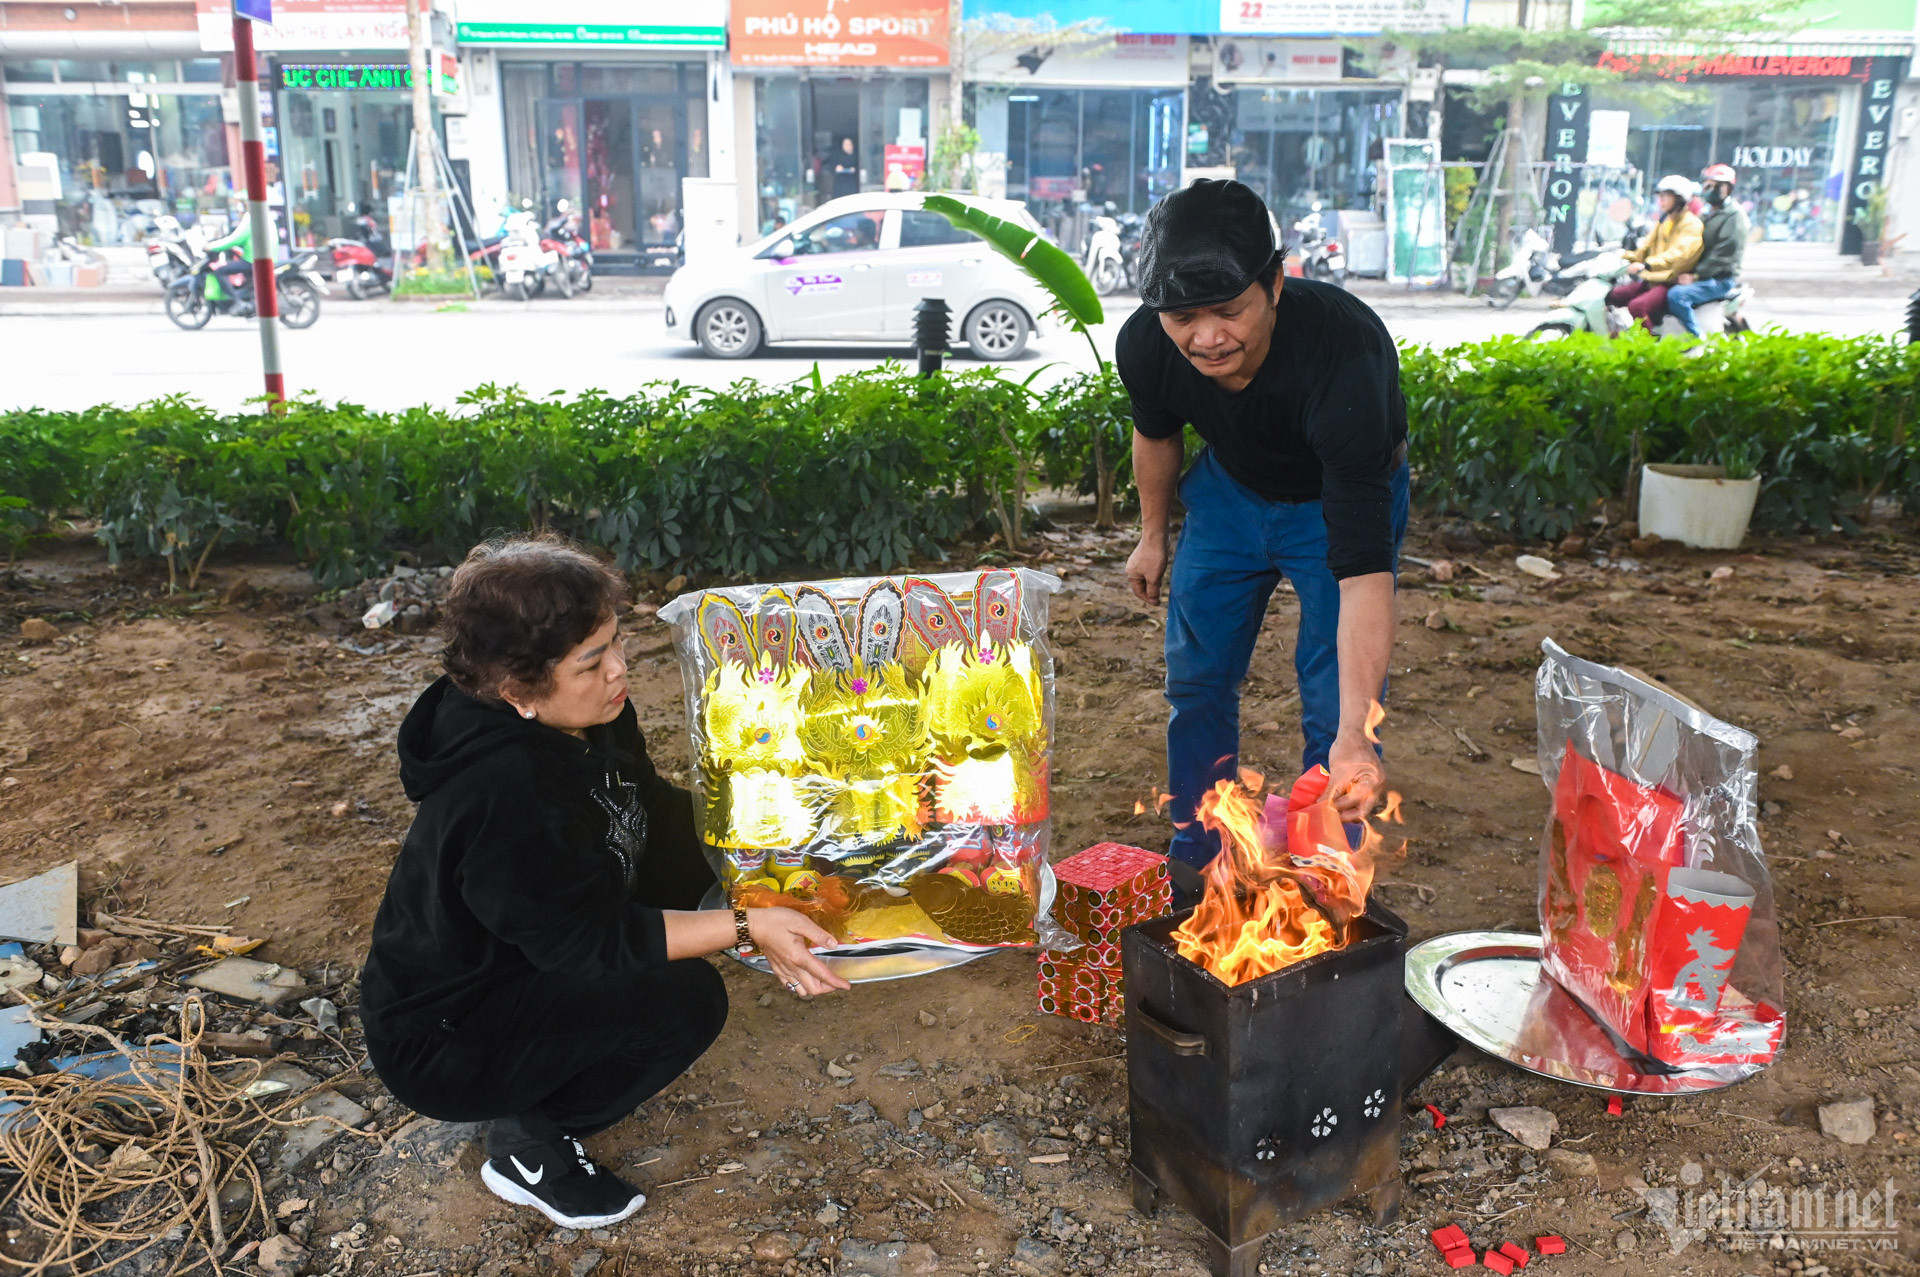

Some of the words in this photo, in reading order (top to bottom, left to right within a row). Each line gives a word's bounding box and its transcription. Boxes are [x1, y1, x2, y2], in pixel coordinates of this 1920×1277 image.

[1240, 1, 1262, 18] 22
[745, 13, 798, 35] PHÚ
[804, 14, 841, 39] HỘ
[849, 17, 934, 35] SPORT
[805, 43, 877, 56] HEAD
[1547, 81, 1581, 224] EVERON
[1732, 146, 1815, 168] HOLIDAY
